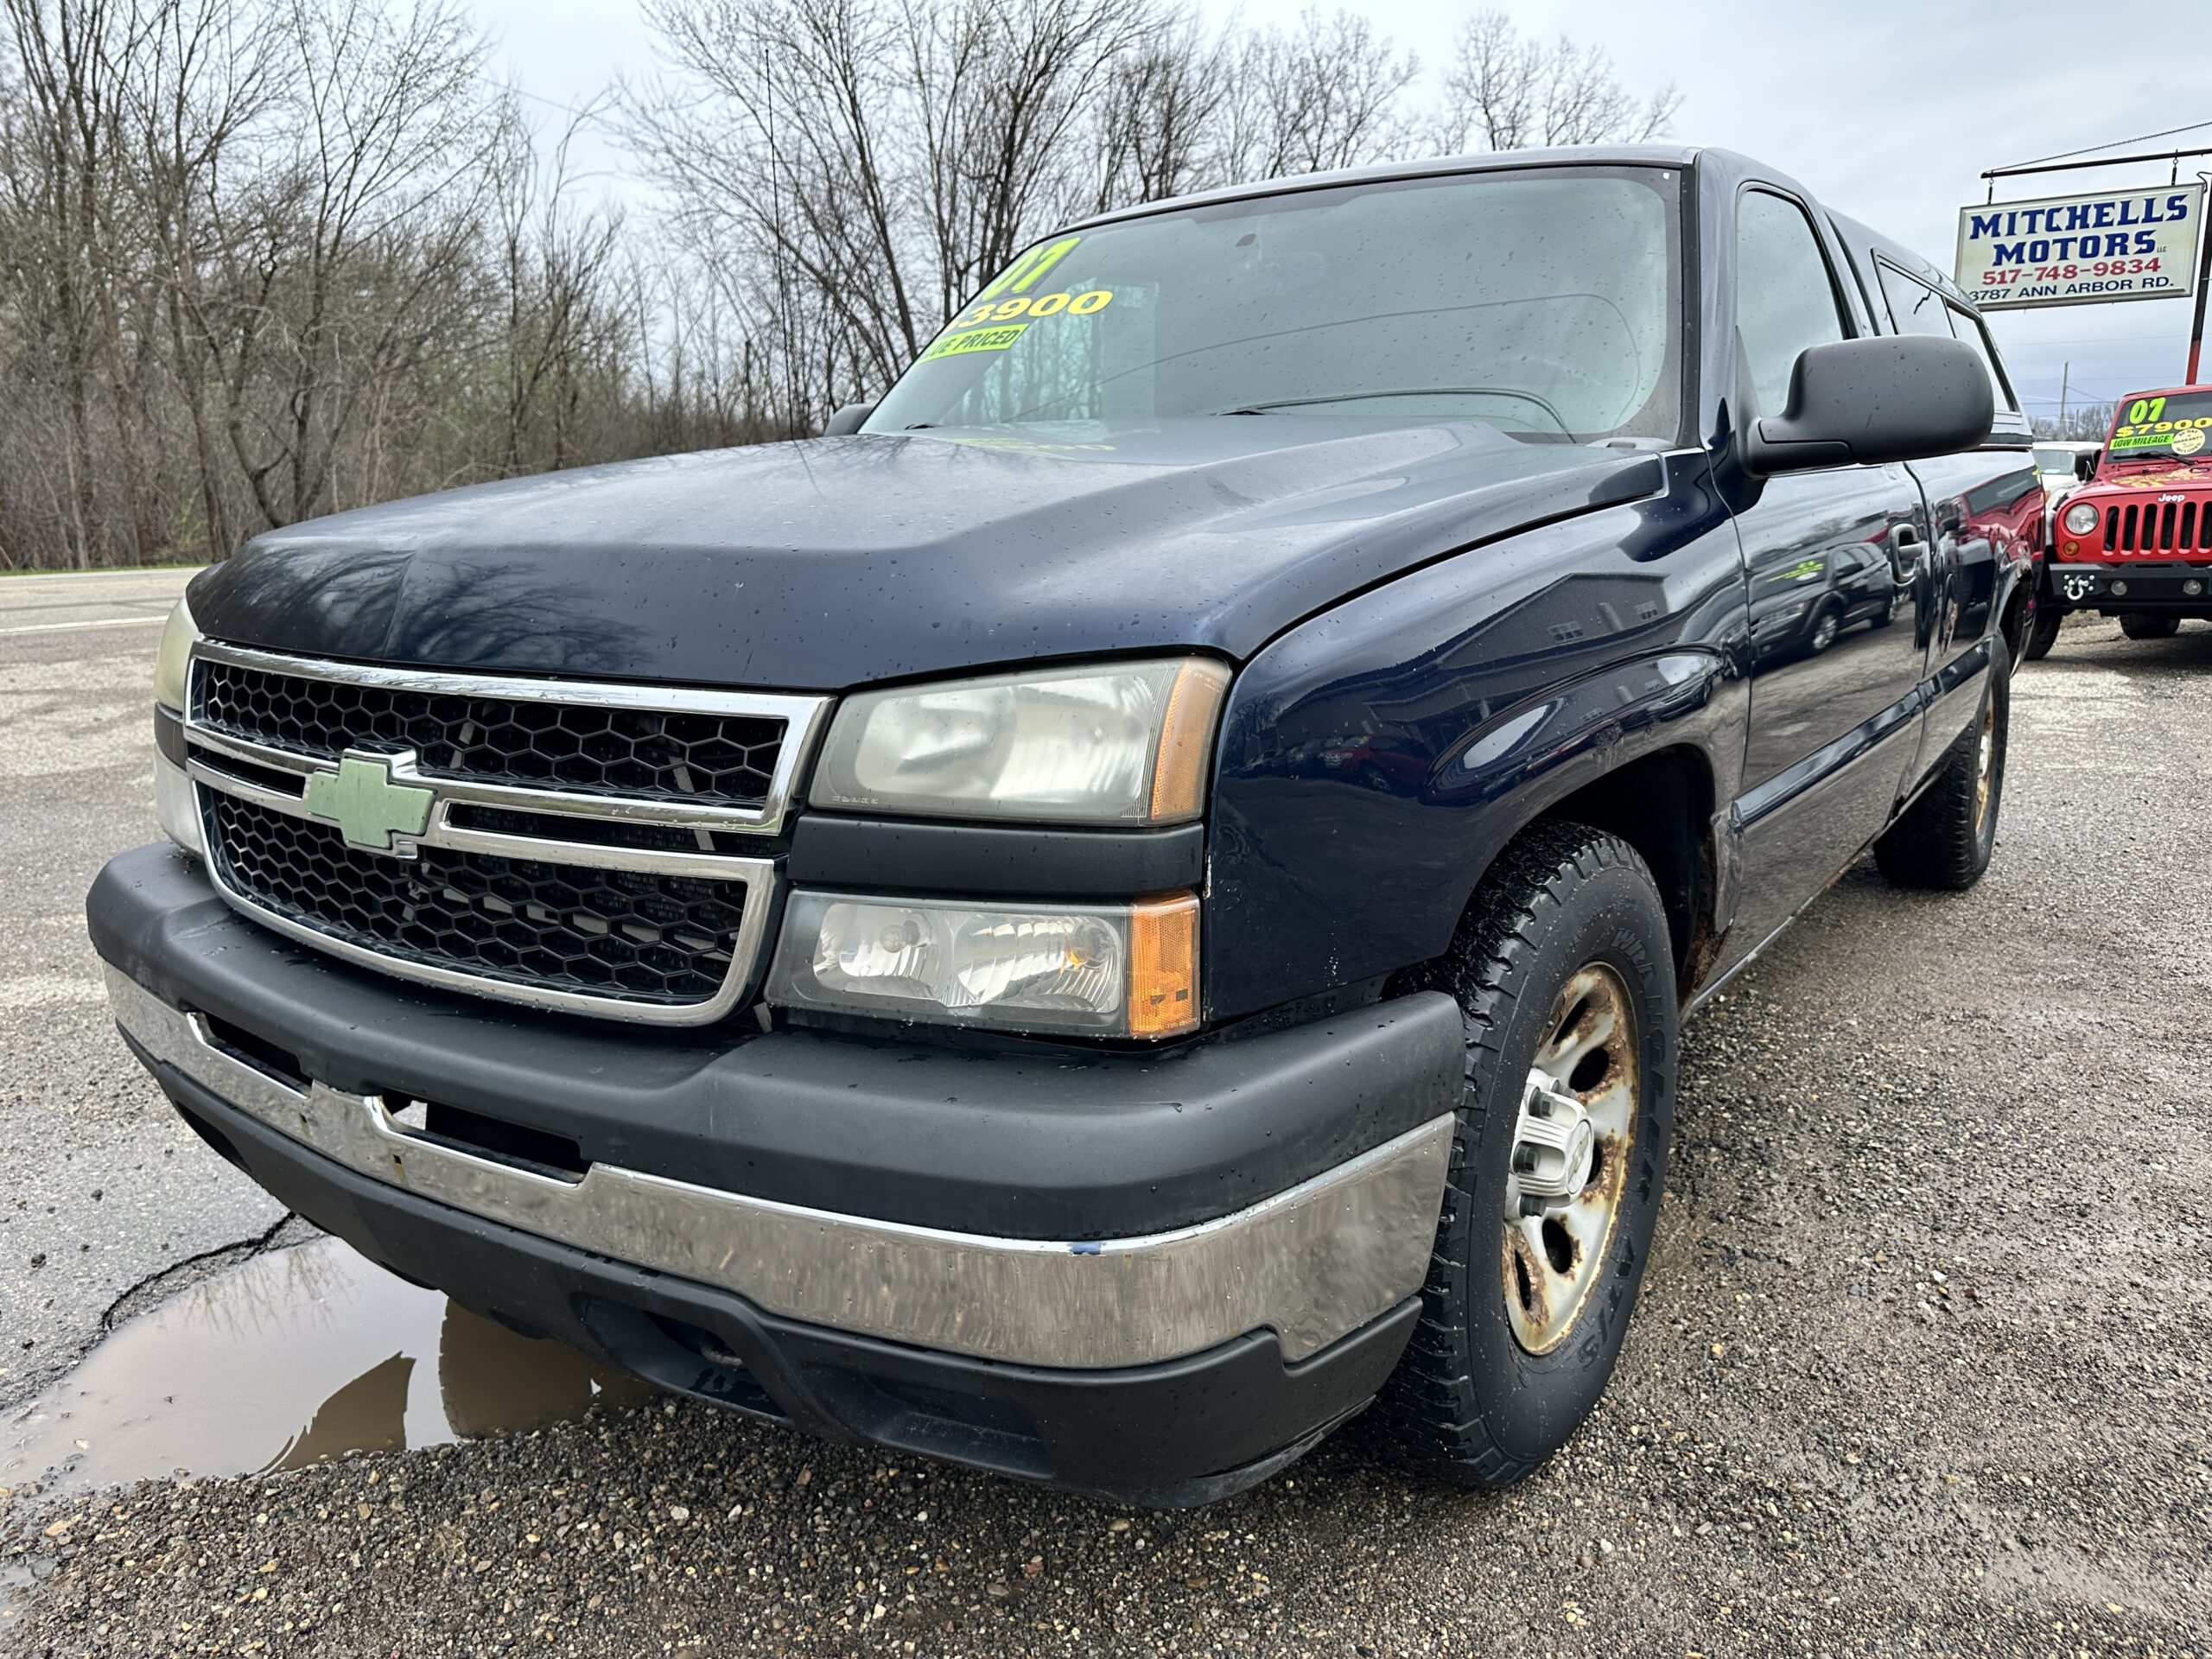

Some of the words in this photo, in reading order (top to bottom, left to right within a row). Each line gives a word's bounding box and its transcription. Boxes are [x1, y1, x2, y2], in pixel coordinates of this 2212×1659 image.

[1969, 194, 2189, 239] MITCHELLS
[1993, 230, 2157, 266] MOTORS
[1982, 257, 2161, 285] 517-748-9834
[1970, 289, 2011, 302] 3787
[2018, 285, 2056, 297] ANN
[2065, 279, 2133, 295] ARBOR
[2142, 276, 2174, 289] RD.
[952, 329, 1020, 351] PRICED
[2130, 397, 2166, 424] 07
[2116, 417, 2212, 437] $7900
[2113, 437, 2133, 448] LOW
[2133, 435, 2170, 447] MILEAGE
[2158, 494, 2185, 503] Jeep
